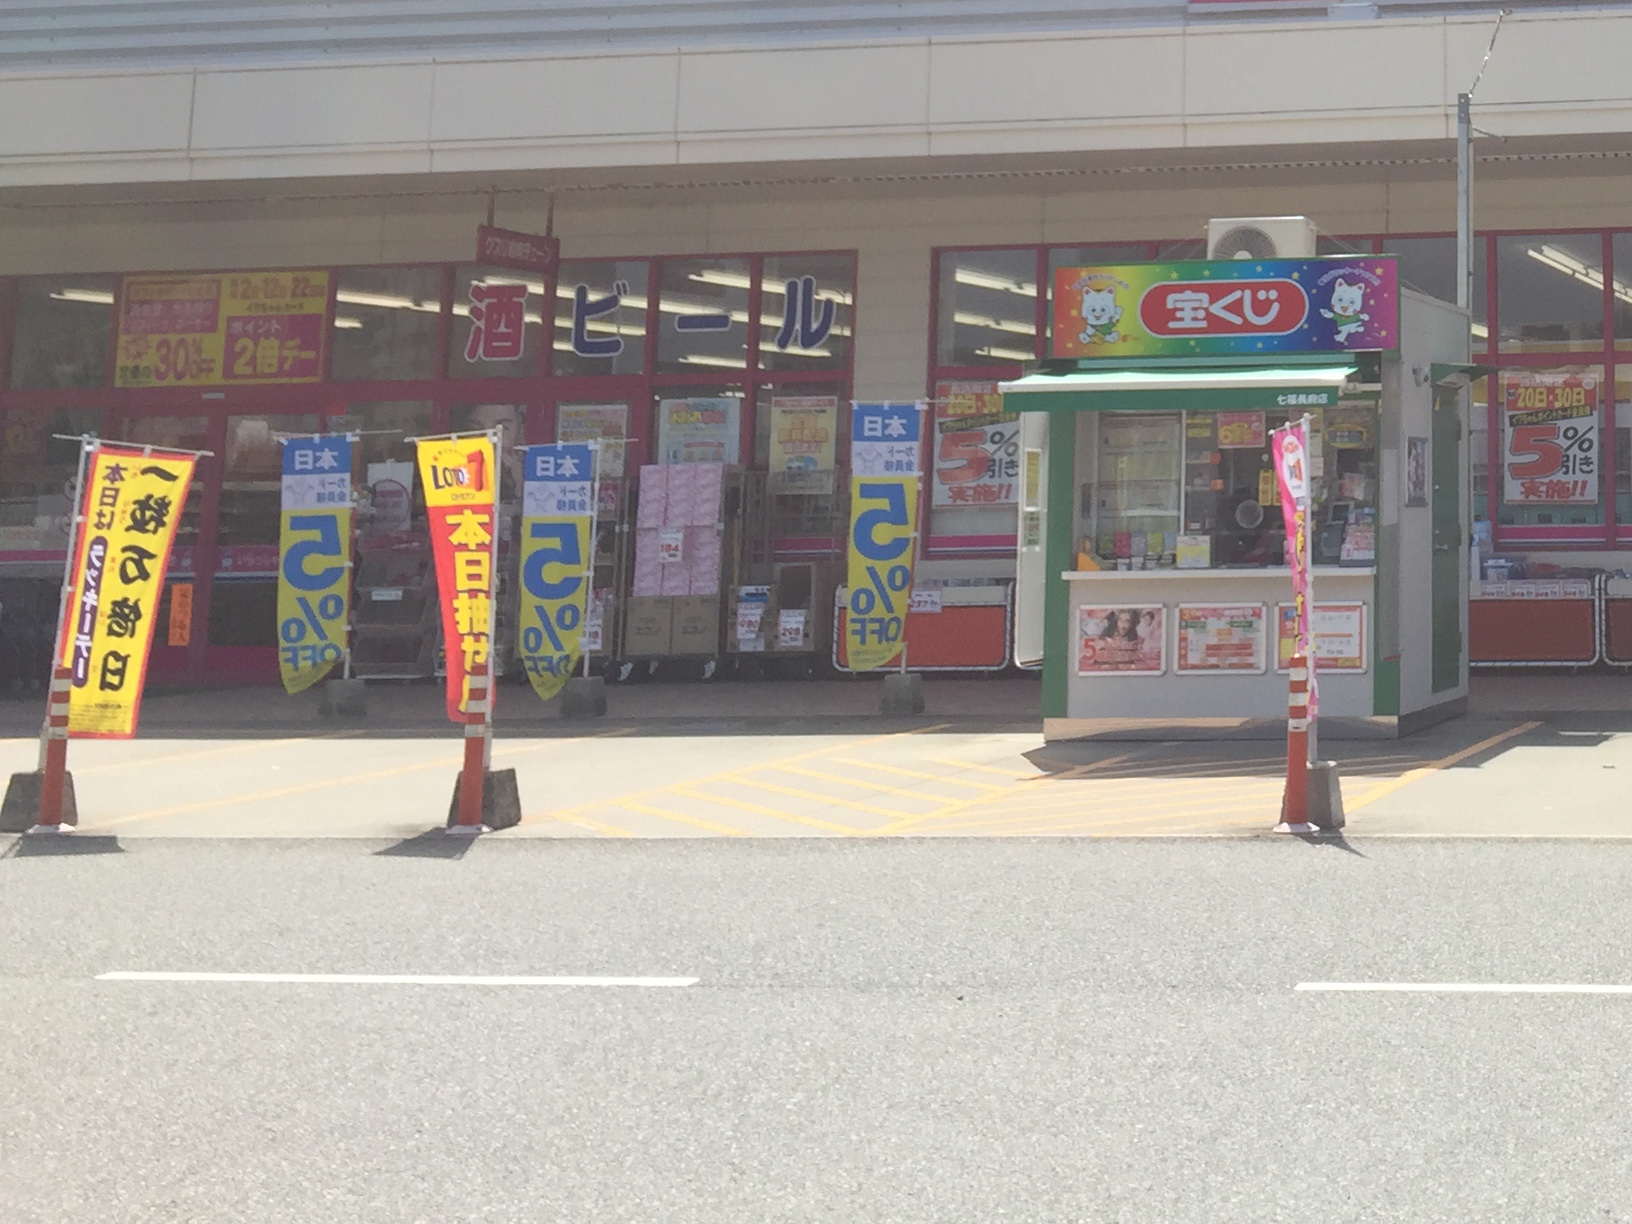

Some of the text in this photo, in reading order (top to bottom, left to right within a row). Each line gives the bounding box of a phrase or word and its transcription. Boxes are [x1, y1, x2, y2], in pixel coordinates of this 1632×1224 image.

[465, 276, 837, 362] 酒 ビール
[1166, 289, 1281, 329] 宝くじ
[233, 336, 317, 376] 2倍デー
[1276, 393, 1329, 405] 七福長府店
[431, 463, 465, 490] LOTO
